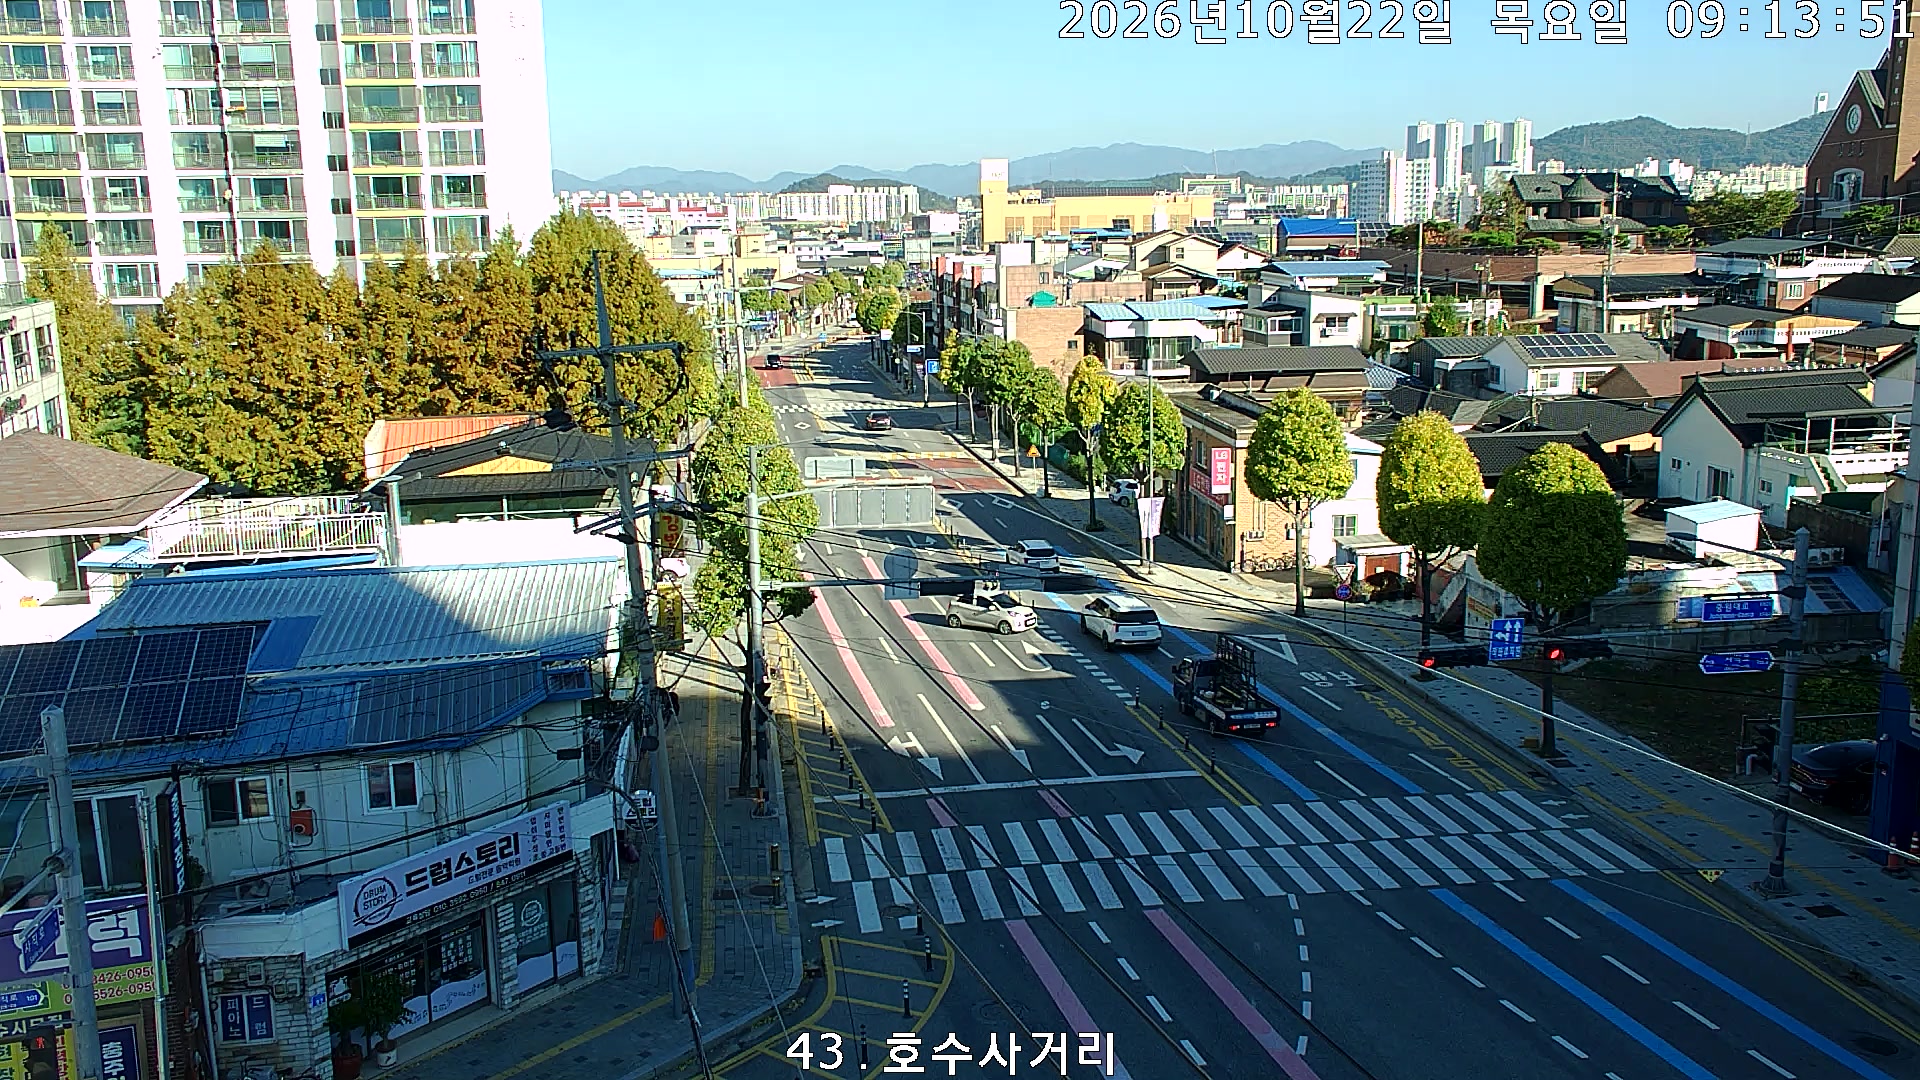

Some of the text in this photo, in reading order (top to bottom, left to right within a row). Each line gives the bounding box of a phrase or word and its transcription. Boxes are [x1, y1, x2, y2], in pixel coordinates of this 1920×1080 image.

[1354, 689, 1510, 792] 주정차금지
[405, 831, 520, 898] 드럼스토리
[362, 893, 388, 910] STORY
[363, 883, 387, 900] DRUM
